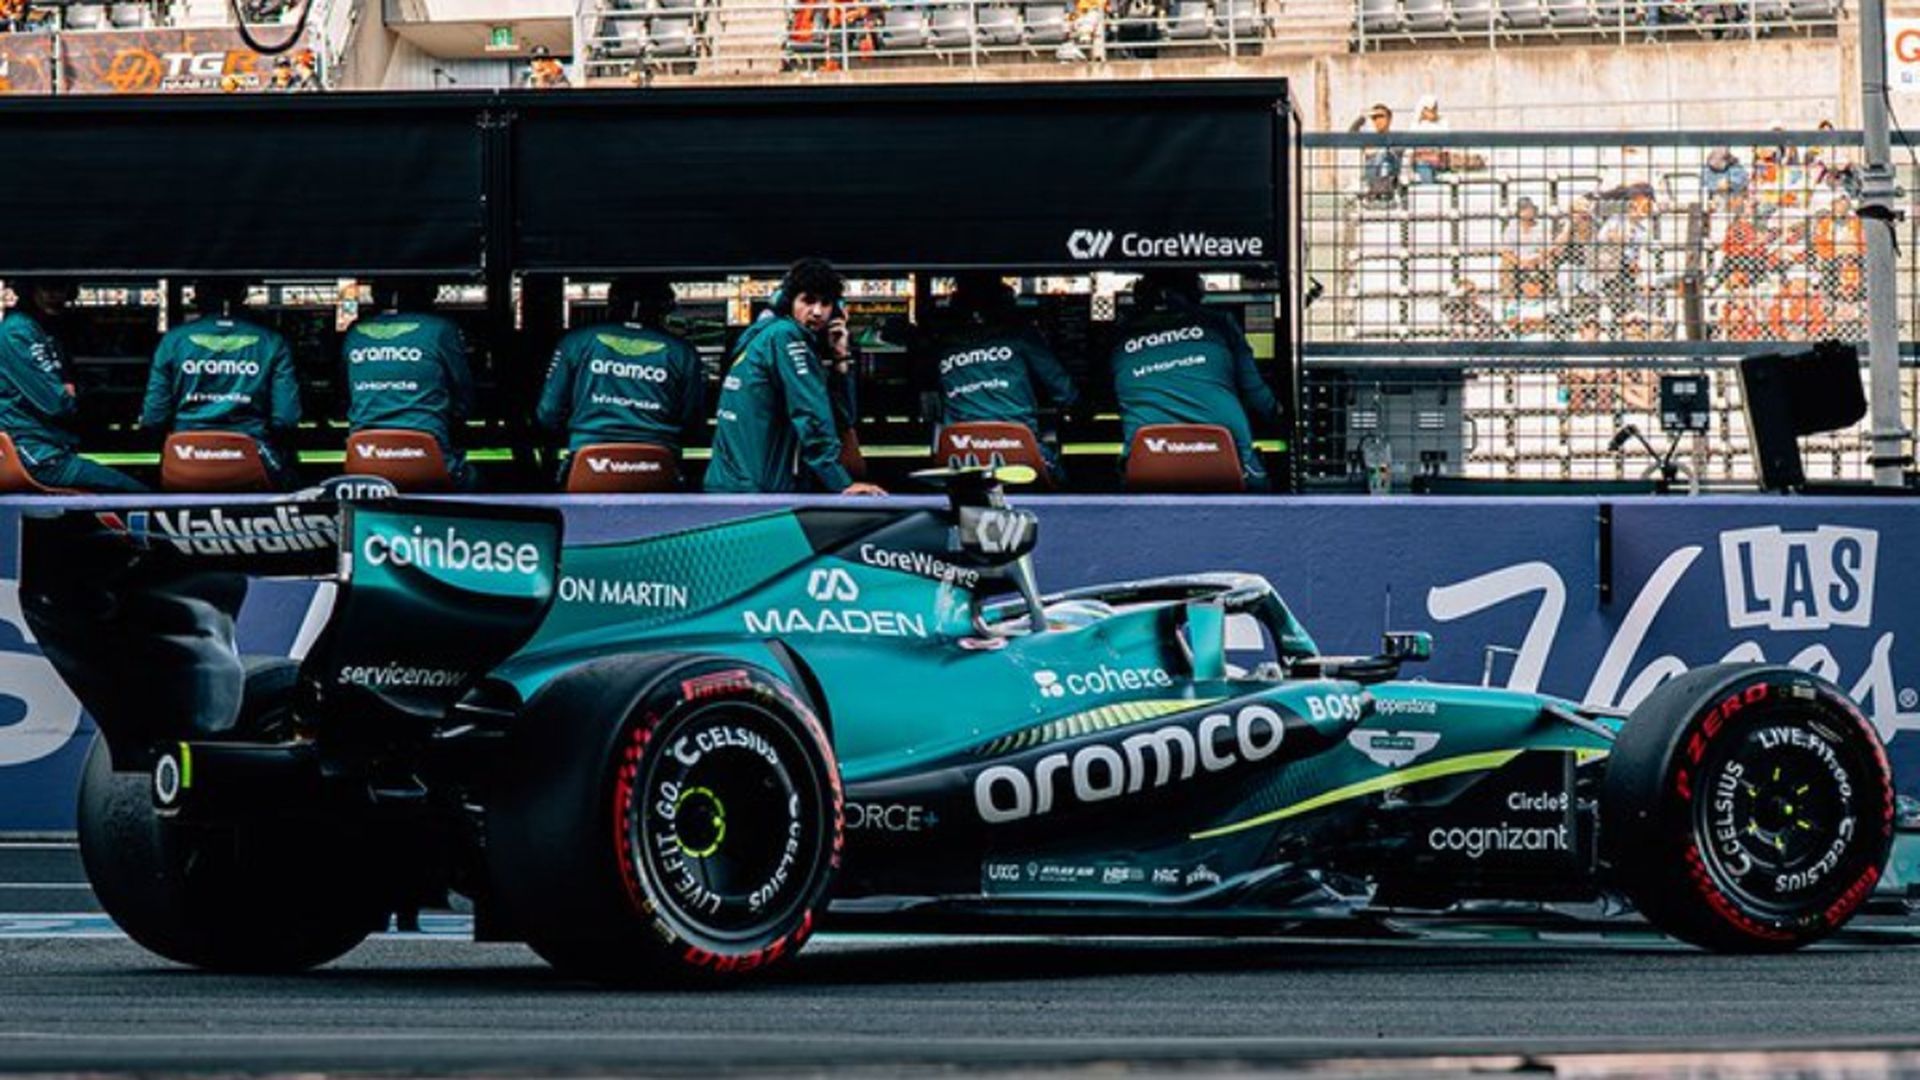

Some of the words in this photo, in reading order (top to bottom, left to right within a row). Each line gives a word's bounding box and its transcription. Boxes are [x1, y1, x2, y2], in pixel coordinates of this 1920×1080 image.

[1121, 232, 1263, 257] CoreWeave
[1125, 326, 1204, 353] aramco
[182, 359, 260, 376] aramco
[350, 346, 423, 364] aramco
[939, 346, 1013, 374] aramco
[590, 359, 668, 383] aramco
[363, 525, 540, 574] coinbase
[860, 543, 980, 589] CoreWeave
[1738, 537, 1864, 618] LAS
[558, 577, 596, 601] ON
[602, 583, 688, 608] MARTIN
[743, 609, 927, 639] MAADEN
[338, 661, 468, 687] servicenow
[1066, 664, 1175, 697] cohere
[1305, 694, 1361, 720] BOSS
[695, 726, 780, 766] CELSIUS
[974, 705, 1286, 824] aramco
[1714, 759, 1745, 856] CELSIUS
[1428, 821, 1569, 857] cognizant
